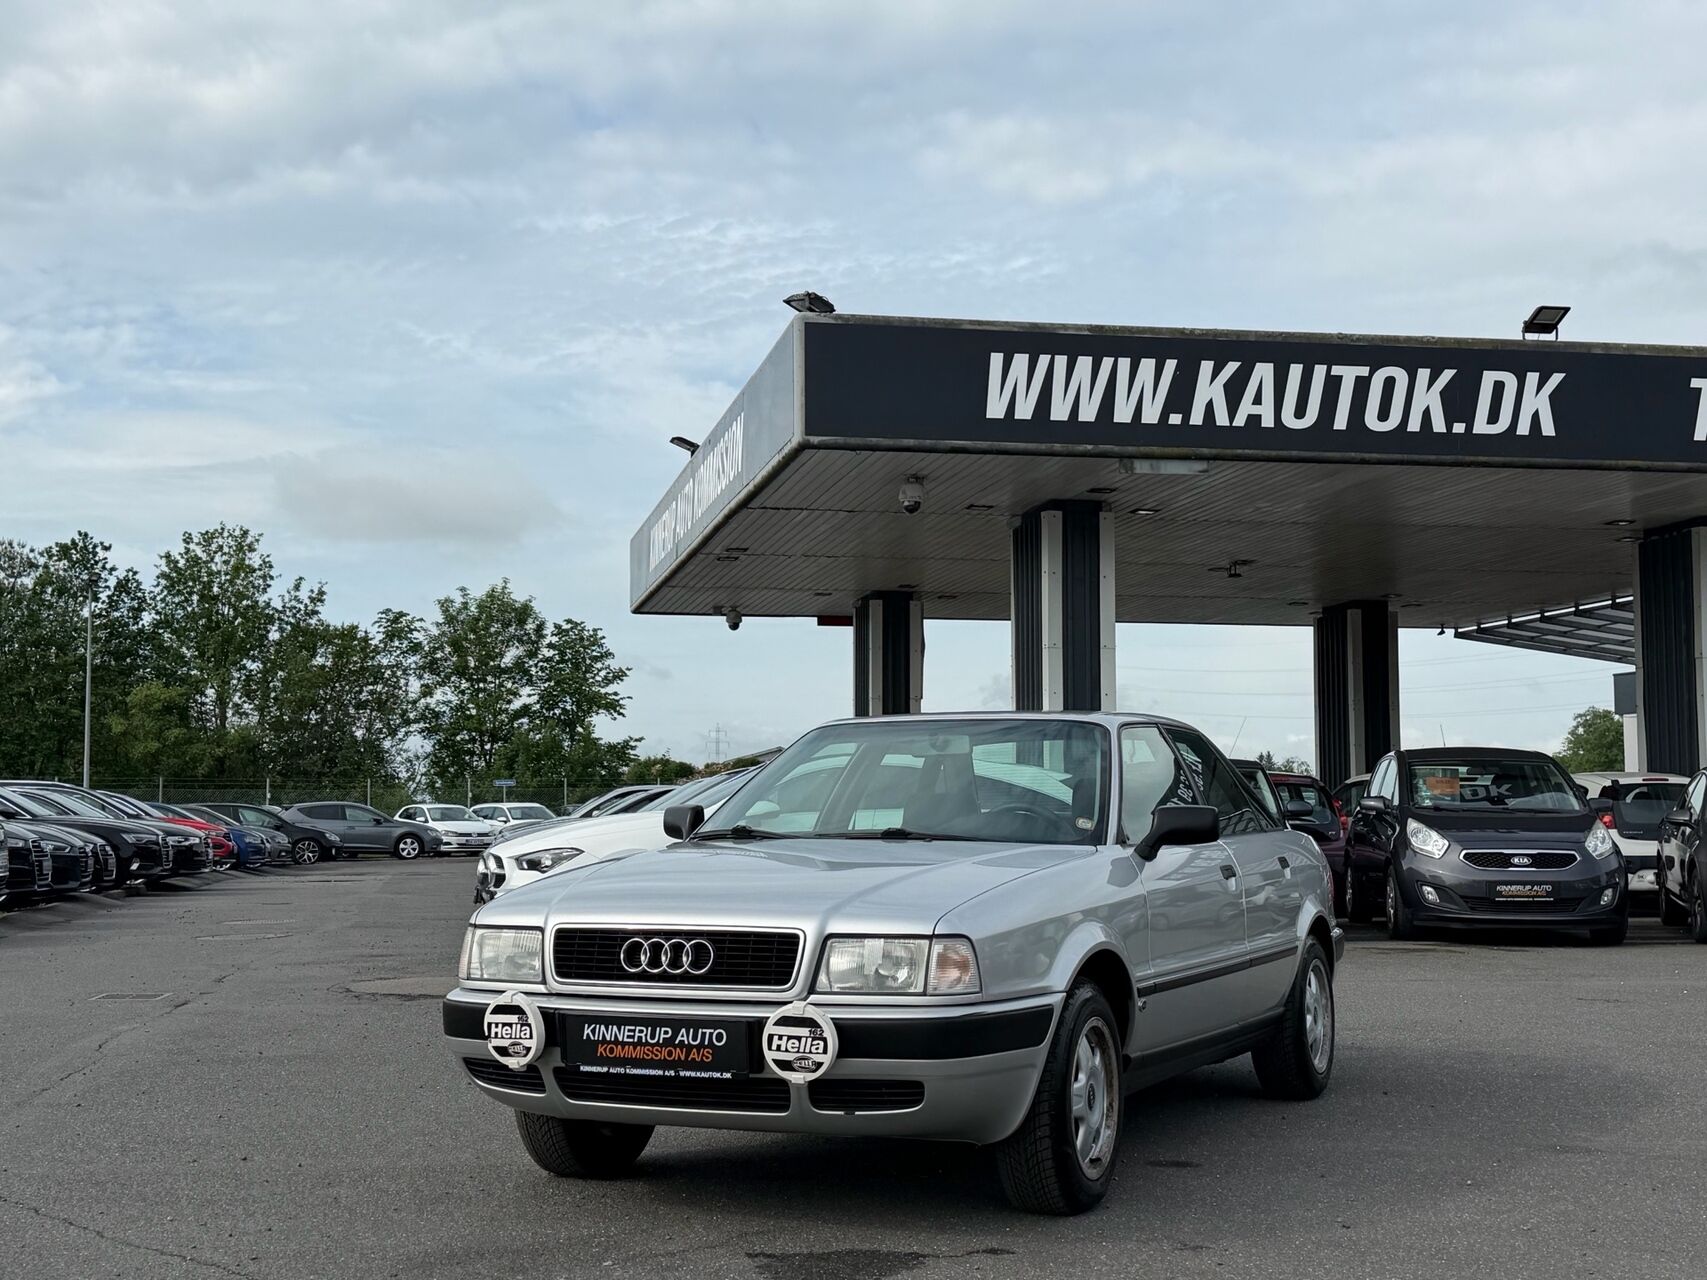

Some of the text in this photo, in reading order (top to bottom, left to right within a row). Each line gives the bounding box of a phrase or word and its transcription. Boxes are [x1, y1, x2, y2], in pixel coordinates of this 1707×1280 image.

[985, 352, 1567, 437] WWW.KAUTOK.DK
[676, 478, 693, 541] AUTO
[693, 412, 744, 522] KOMMISSION
[490, 1023, 530, 1039] Hella
[583, 1023, 727, 1046] KINNERUP AUTO
[808, 1028, 825, 1037] 162
[597, 1044, 713, 1062] KOMMISSION A/S
[771, 1035, 824, 1053] Hella
[626, 1067, 664, 1076] KOMMISSION
